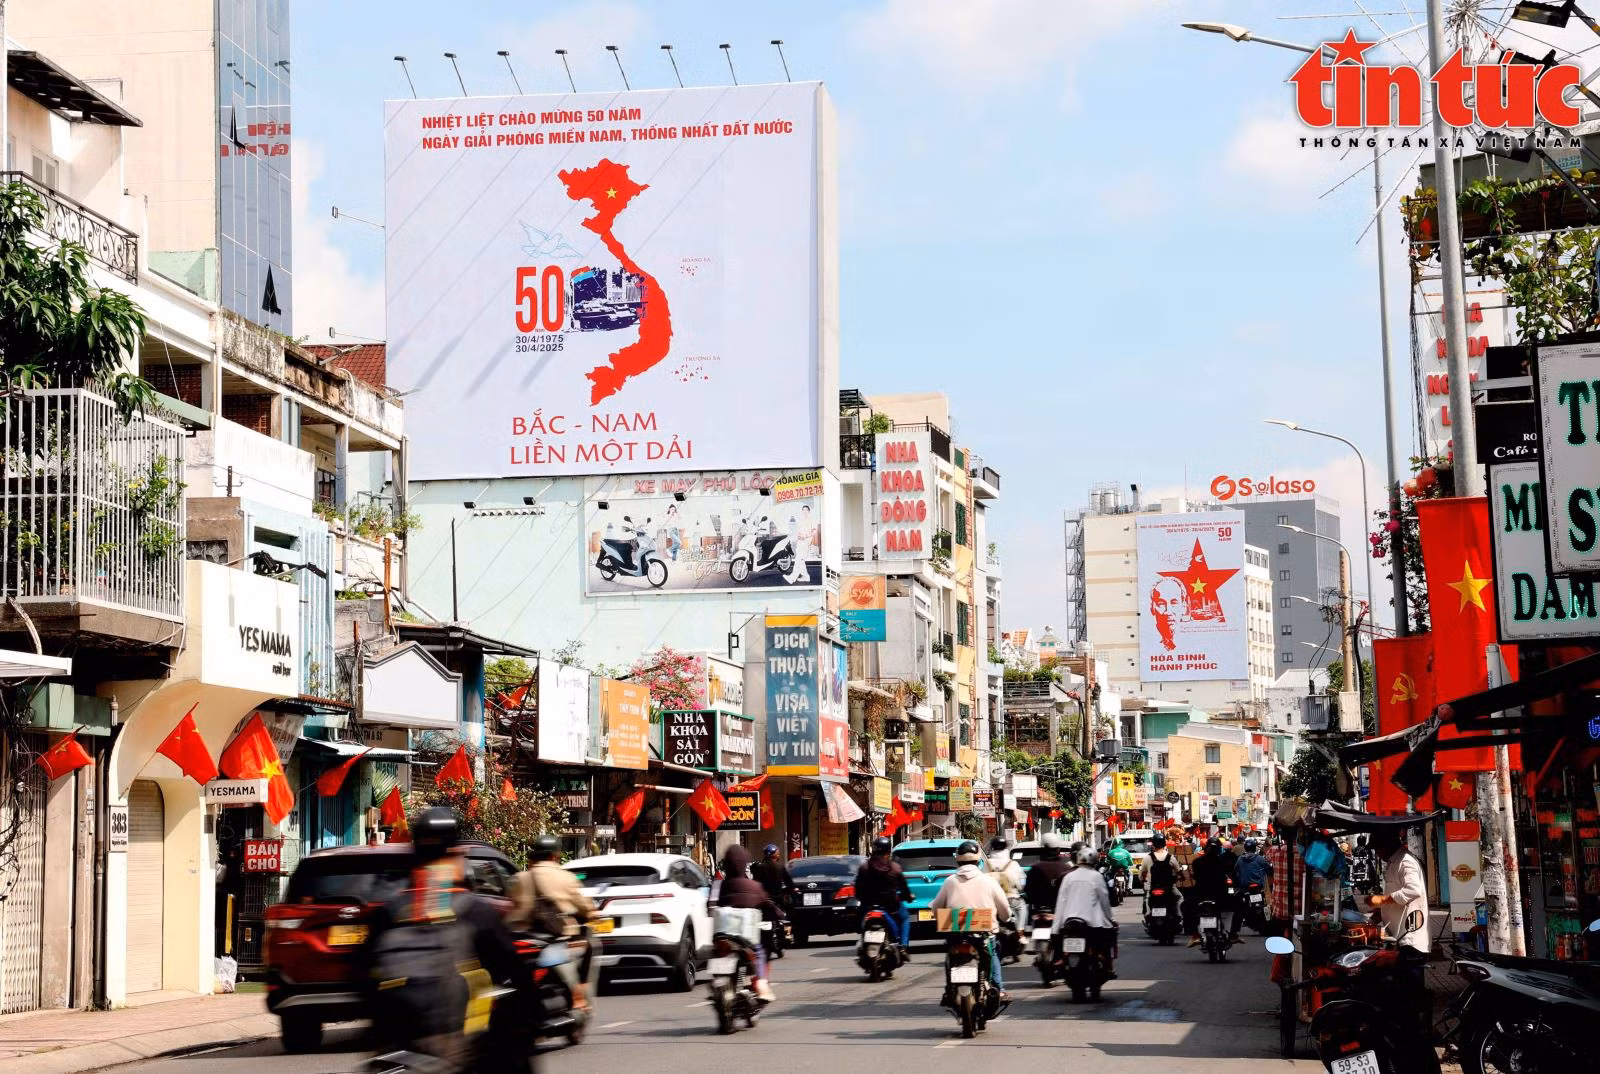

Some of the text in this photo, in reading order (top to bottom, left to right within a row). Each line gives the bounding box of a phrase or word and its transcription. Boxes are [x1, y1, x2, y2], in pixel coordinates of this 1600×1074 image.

[422, 107, 641, 131] NHIỆT LIỆT CHÀO MỪNG 50 NĂM
[422, 118, 793, 150] NGÀY GIẢI PHÓNG MIỀN NAM, THỐNG NHẤT ĐẤT NƯỚC
[515, 265, 565, 333] 50
[515, 334, 564, 344] 30/4/1975
[515, 343, 564, 353] 30/4/2025
[512, 408, 565, 435] BẮC
[592, 412, 657, 433] NAM
[510, 433, 692, 466] LIỀN MỘT DẢI
[885, 441, 919, 464] NHA
[1493, 445, 1529, 458] Café
[634, 479, 656, 494] XE
[703, 474, 737, 492] PHÚ
[805, 471, 820, 481] GIA
[880, 469, 925, 493] KHOA
[1238, 476, 1315, 497] Solaso
[881, 495, 927, 523] ĐÔNG
[886, 529, 923, 552] NAM
[1218, 527, 1232, 537] 50
[774, 633, 809, 651] DỊCH
[769, 654, 816, 676] THUẬT
[1150, 662, 1218, 672] HẠNH PHÚC
[775, 693, 809, 711] VISA
[673, 713, 705, 724] NHA
[776, 715, 809, 735] VIỆT
[670, 725, 708, 736] KHOA
[676, 737, 700, 750] SÀI
[769, 741, 788, 757] UY
[791, 738, 816, 757] TÍN
[674, 751, 704, 764] GÒN
[210, 786, 256, 797] YESMAMA
[111, 812, 127, 834] 383
[728, 808, 754, 821] GÒN
[247, 841, 278, 856] BÁN
[247, 855, 278, 870] CHÓ
[1338, 1054, 1370, 1072] 59-S3
